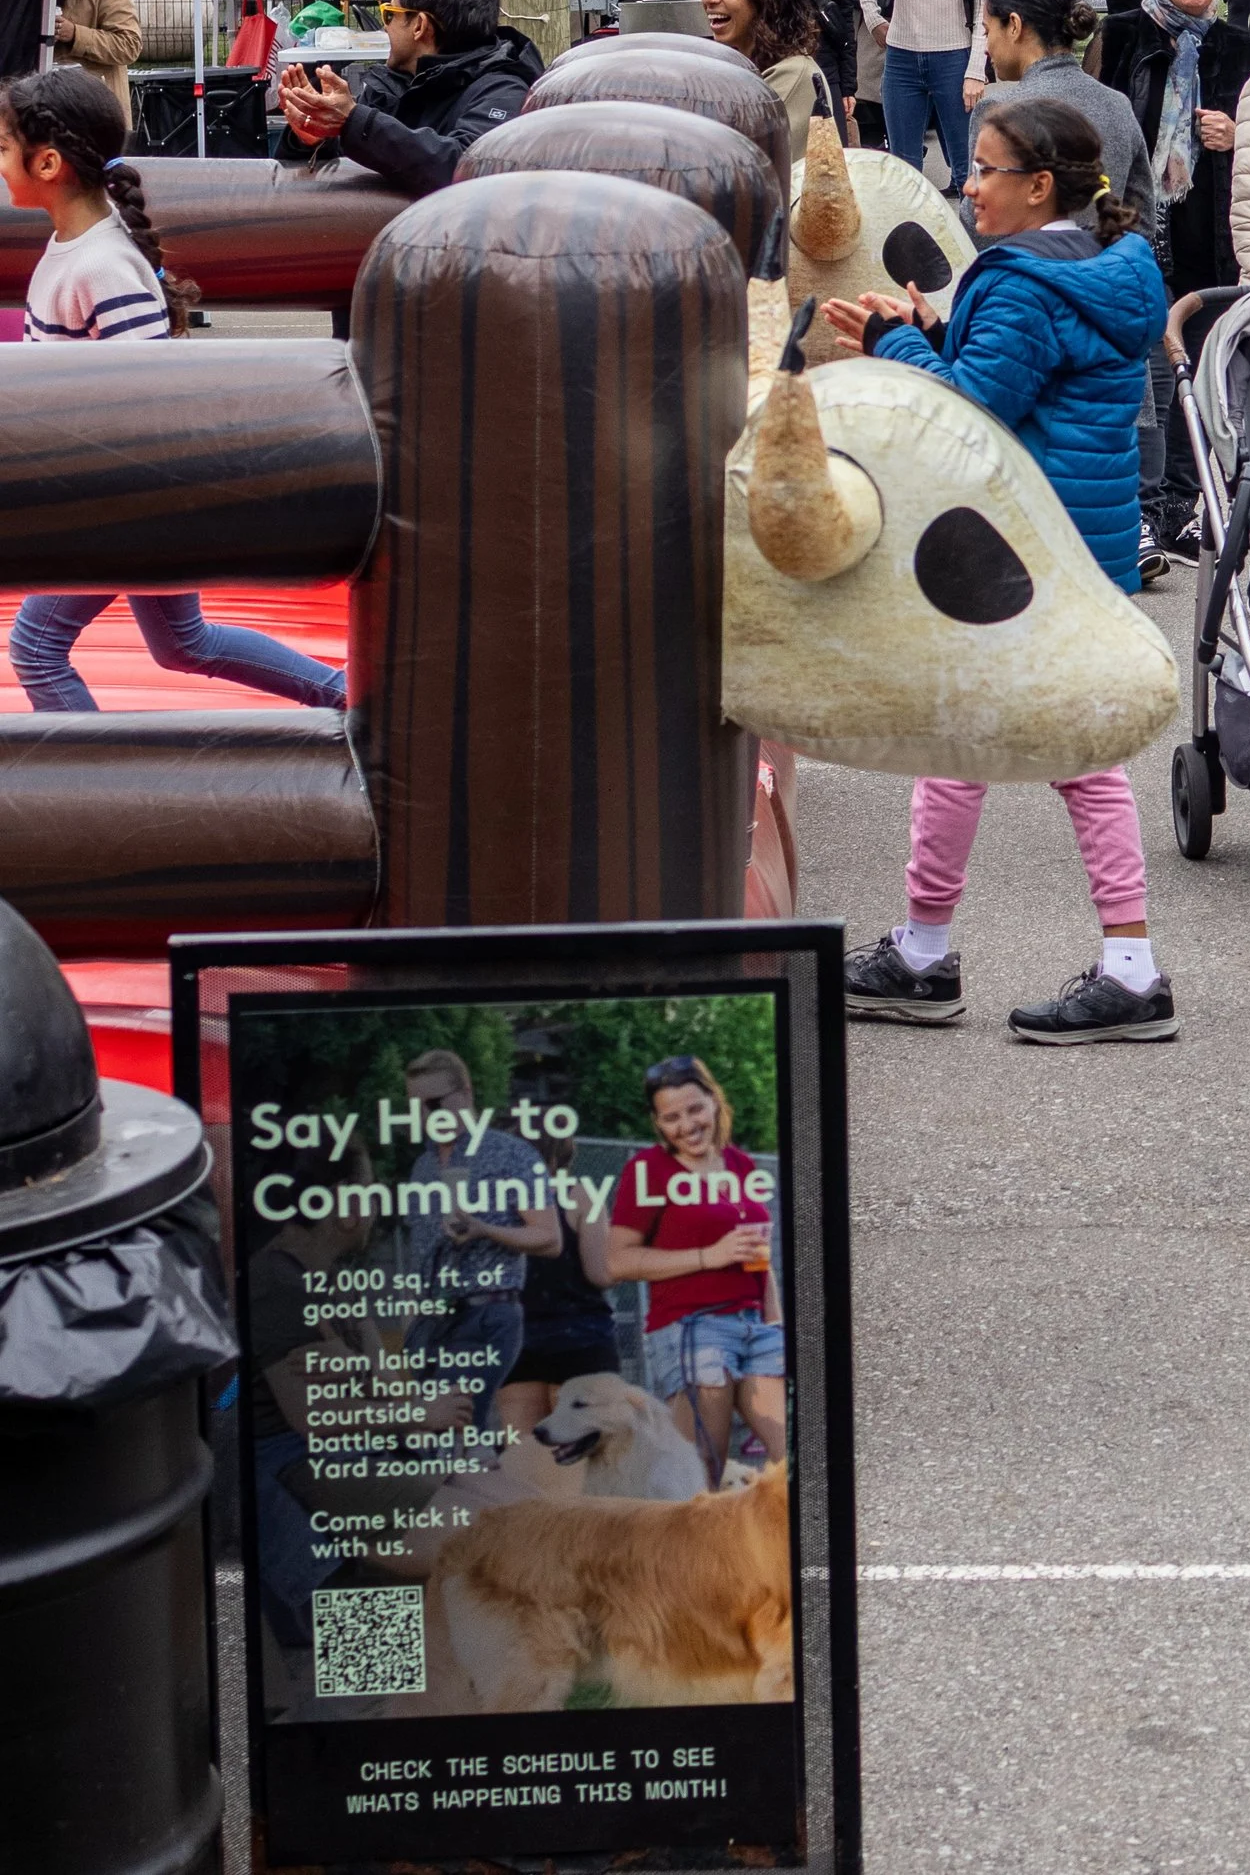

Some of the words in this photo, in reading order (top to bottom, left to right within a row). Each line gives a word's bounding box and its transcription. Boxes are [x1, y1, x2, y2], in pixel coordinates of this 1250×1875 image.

[251, 1102, 358, 1162] Say
[377, 1098, 494, 1156] Hey
[511, 1099, 579, 1139] to
[253, 1161, 615, 1223] Community
[635, 1161, 775, 1208] Lane
[302, 1269, 385, 1295] 12,000
[393, 1272, 430, 1295] sq.
[438, 1266, 469, 1288] ft.
[477, 1264, 505, 1286] of
[303, 1296, 367, 1326] good
[374, 1296, 456, 1317] times.
[305, 1351, 370, 1373] From
[379, 1344, 501, 1370] laid-back
[306, 1376, 365, 1406] park
[372, 1376, 450, 1402] hangs
[457, 1374, 486, 1394] to
[307, 1402, 426, 1426] courtside
[308, 1430, 399, 1453] battles
[405, 1427, 454, 1449] and
[463, 1424, 522, 1447] Bark
[308, 1457, 368, 1480] Yard
[376, 1453, 489, 1477] zoomies.
[310, 1510, 386, 1532] Come
[393, 1506, 444, 1529] kick
[452, 1505, 471, 1526] it
[311, 1536, 368, 1559] with
[376, 1539, 413, 1556] us.
[360, 1760, 432, 1782] CHECK
[447, 1756, 489, 1777] THE
[502, 1751, 616, 1775] SCHEDULE
[631, 1749, 660, 1769] TO
[672, 1747, 715, 1767] SEE
[346, 1792, 419, 1814] WHATS
[433, 1785, 561, 1810] HAPPENING
[575, 1782, 632, 1803] THIS
[645, 1778, 728, 1800] MONTH!
